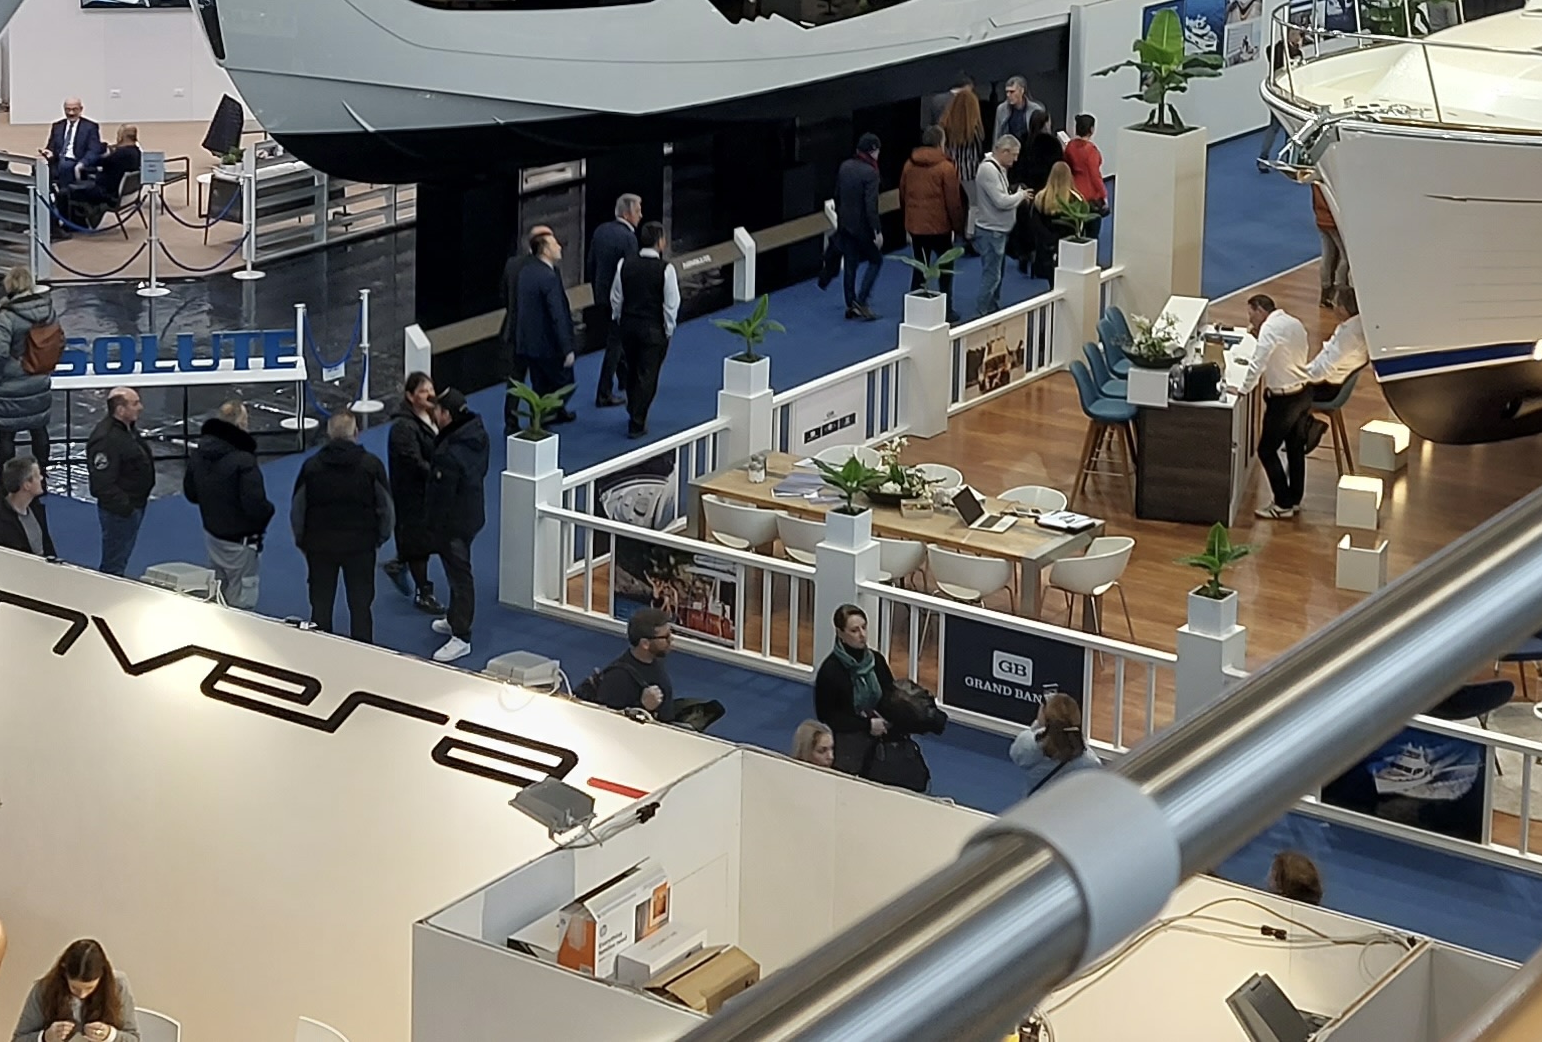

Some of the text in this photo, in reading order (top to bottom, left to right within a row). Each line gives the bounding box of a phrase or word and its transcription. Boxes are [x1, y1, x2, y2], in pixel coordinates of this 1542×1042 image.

[999, 659, 1028, 677] GB
[964, 676, 1045, 705] GRAND BAN
